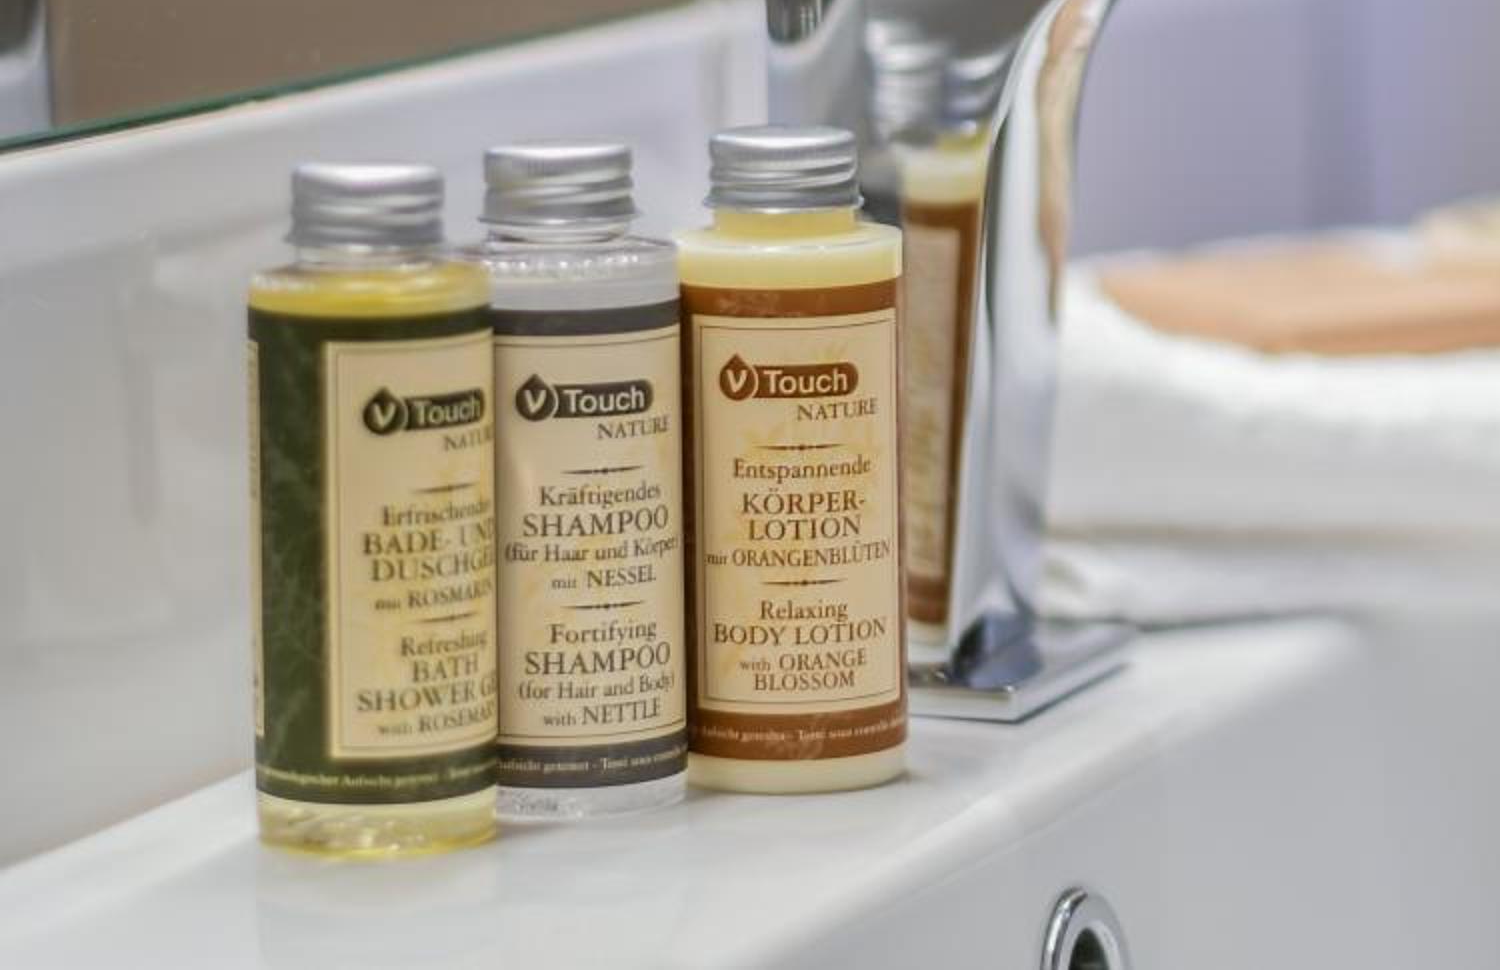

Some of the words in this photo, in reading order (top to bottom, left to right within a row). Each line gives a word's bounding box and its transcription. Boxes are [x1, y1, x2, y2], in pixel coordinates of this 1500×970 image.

[726, 370, 748, 393] V
[763, 368, 848, 394] Touch
[373, 402, 396, 427] V
[413, 396, 481, 425] Touch
[524, 389, 547, 414] V
[563, 385, 645, 413] Touch
[797, 398, 878, 422] NATURE
[597, 415, 668, 440] NATURE
[733, 454, 872, 484] Entspannende
[741, 487, 865, 515] KÖRPER-
[523, 504, 669, 538] SHAMPOO
[749, 514, 862, 541] LOTION
[371, 545, 496, 582] DUSCHGE
[504, 541, 539, 562] (für
[544, 544, 590, 562] Haar
[595, 540, 629, 561] und
[732, 540, 892, 566] ORANGENBLÜTEN
[551, 575, 577, 589] mit
[586, 563, 657, 588] NESSEL
[761, 599, 849, 624] Relaxing
[549, 619, 657, 646] Fortifying
[714, 623, 785, 646] BODY
[794, 617, 887, 646] LOTION
[412, 652, 479, 683] BATH
[524, 641, 671, 675] SHAMPOO
[740, 658, 771, 672] with
[779, 648, 868, 672] ORANGE
[357, 680, 476, 711] SHOWER
[518, 682, 552, 700] (for
[557, 681, 597, 699] Hair
[603, 677, 635, 696] and
[754, 672, 855, 692] BLOSSOM
[543, 713, 577, 726] with
[581, 698, 661, 725] NETTLE
